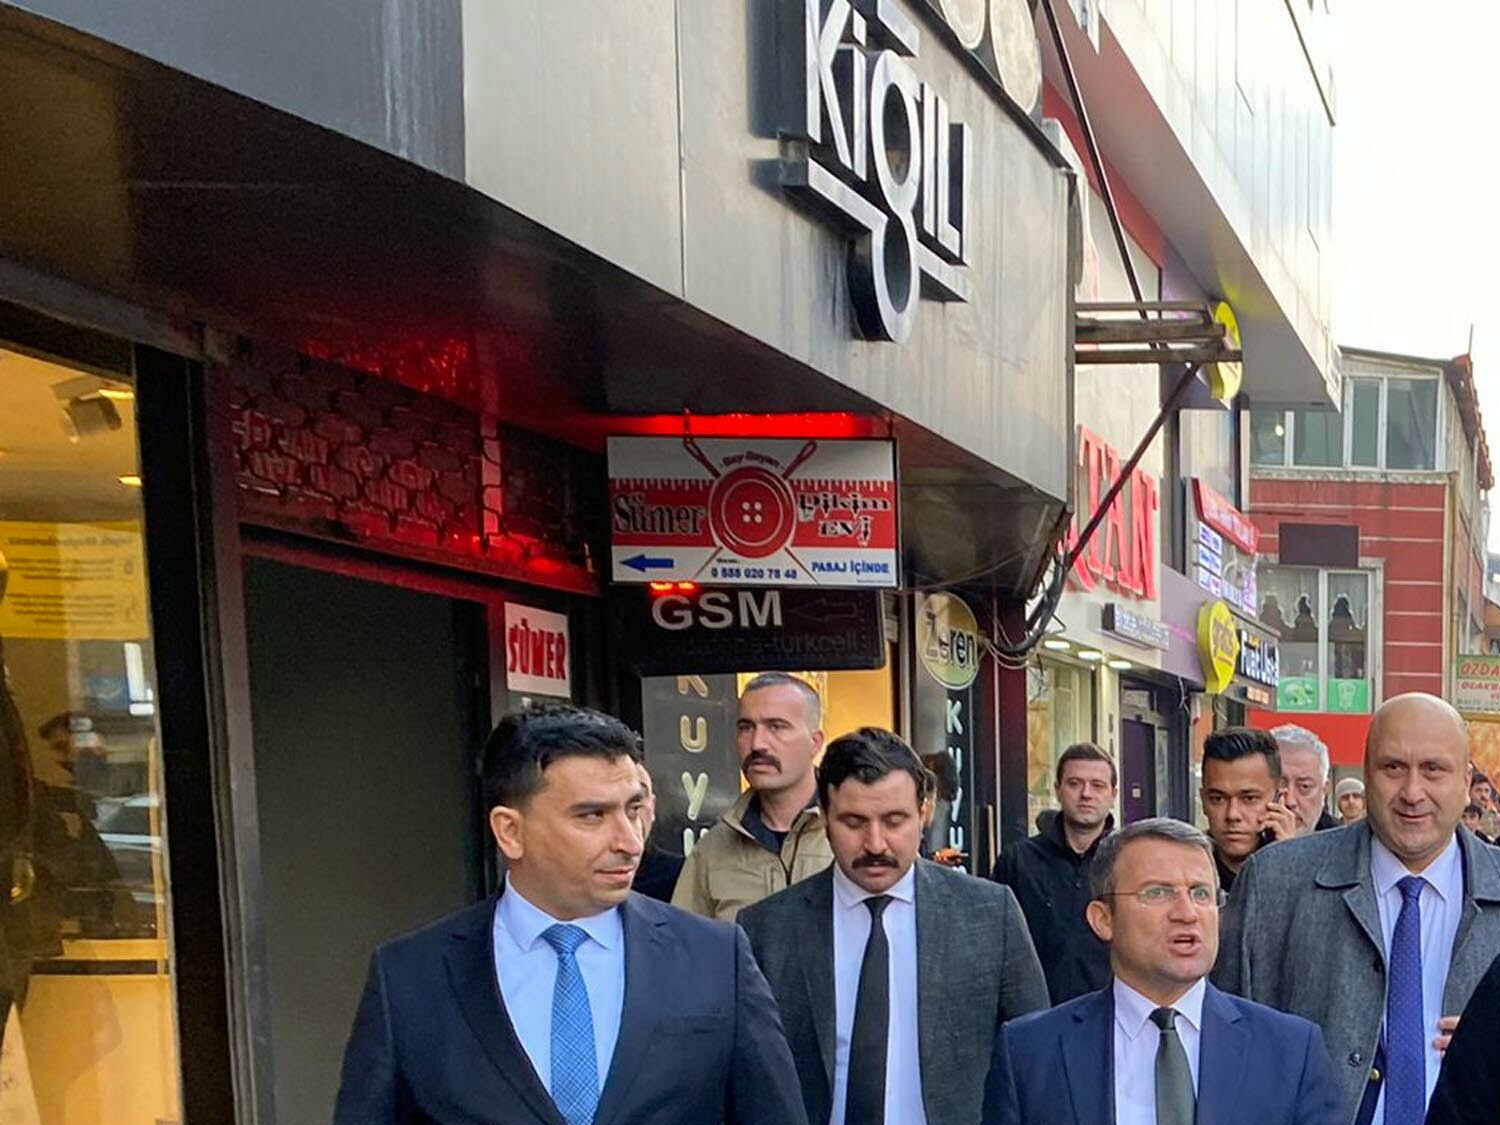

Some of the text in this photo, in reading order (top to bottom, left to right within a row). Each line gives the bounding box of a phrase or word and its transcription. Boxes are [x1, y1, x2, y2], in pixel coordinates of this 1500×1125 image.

[613, 493, 706, 535] Sümer
[811, 559, 890, 576] PASAJ İÇİNDE
[652, 590, 783, 631] GSM
